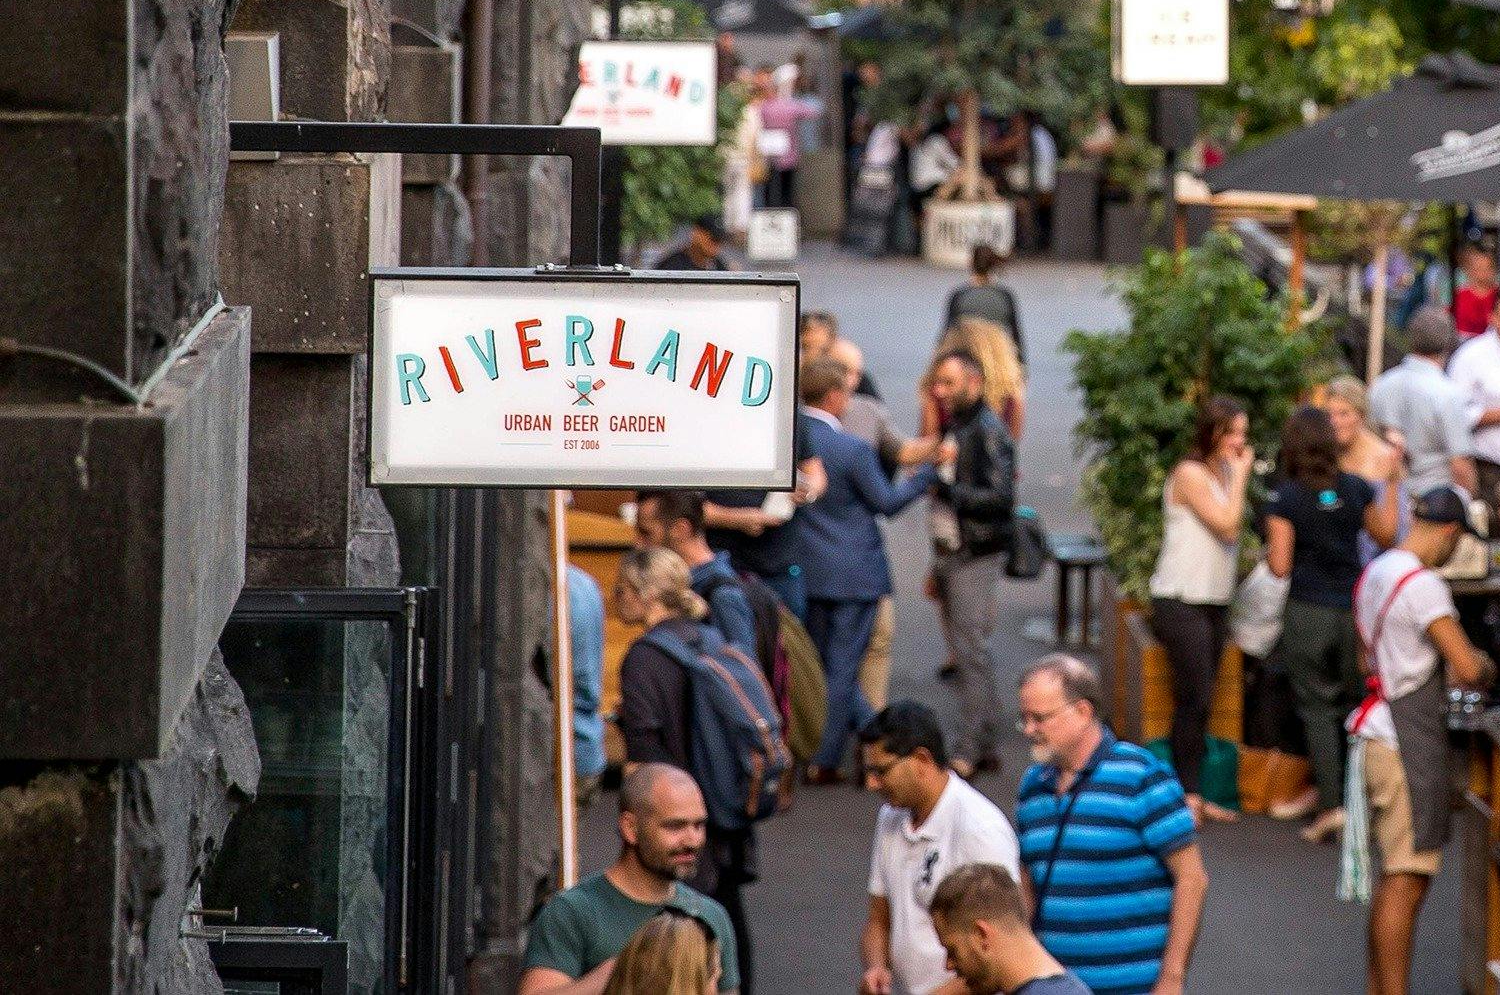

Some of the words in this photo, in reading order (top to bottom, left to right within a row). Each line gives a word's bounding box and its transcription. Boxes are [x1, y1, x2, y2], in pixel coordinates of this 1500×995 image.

[395, 314, 773, 406] RIVERLAND
[504, 414, 552, 432] URBAN
[563, 415, 599, 432] BEER
[609, 415, 666, 433] GARDEN
[563, 439, 579, 450] EST
[580, 439, 600, 450] 2006
